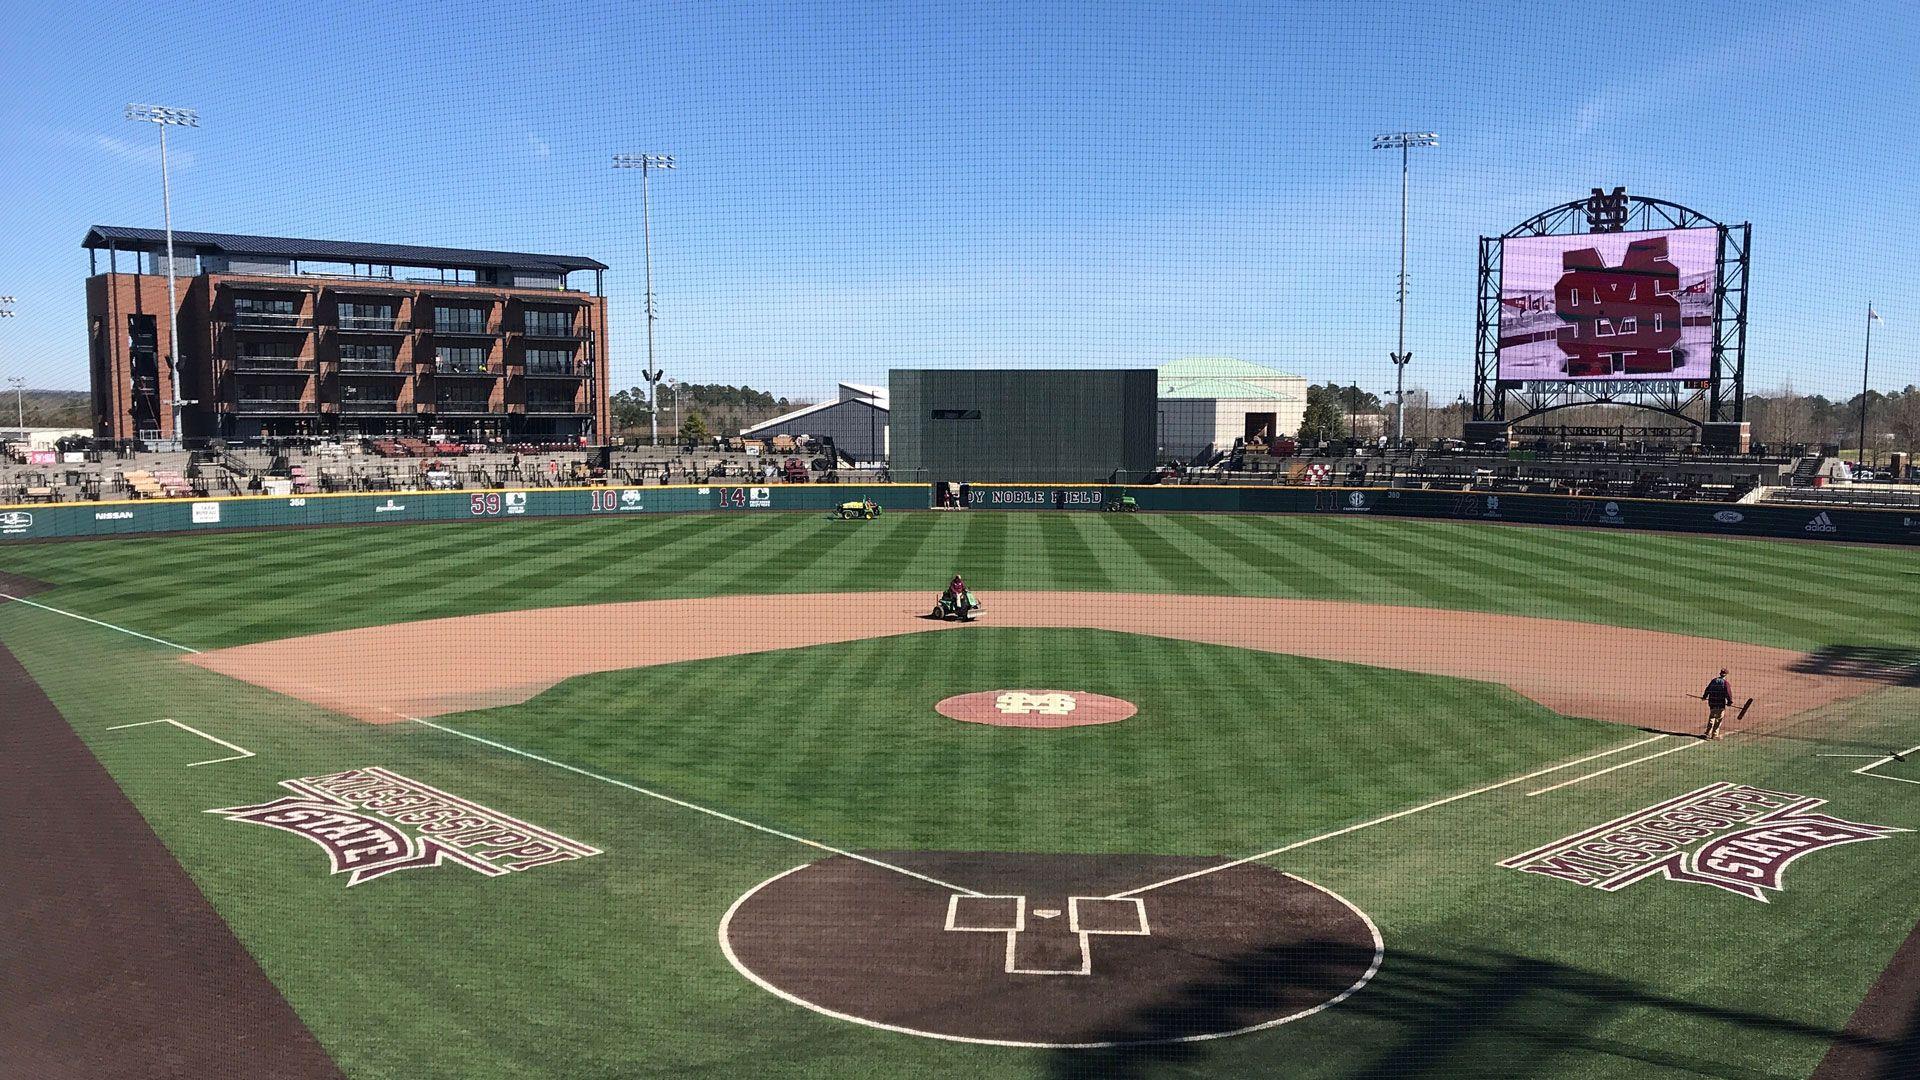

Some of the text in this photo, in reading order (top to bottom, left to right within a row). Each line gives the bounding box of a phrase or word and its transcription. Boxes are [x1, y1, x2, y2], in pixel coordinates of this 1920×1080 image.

[1576, 381, 1681, 393] FOUNDATION
[471, 493, 500, 514] 59
[592, 490, 617, 510] 10
[719, 488, 745, 507] 14
[991, 491, 1045, 503] NOBLE
[1350, 491, 1365, 507] SEC
[95, 511, 134, 520] NISSAN
[1805, 524, 1837, 533] adidas
[300, 769, 582, 871] MISSISSIPPI
[266, 806, 401, 864] STATE
[1518, 785, 1806, 886] MISSISSIPPI
[1703, 824, 1856, 878] STATE
